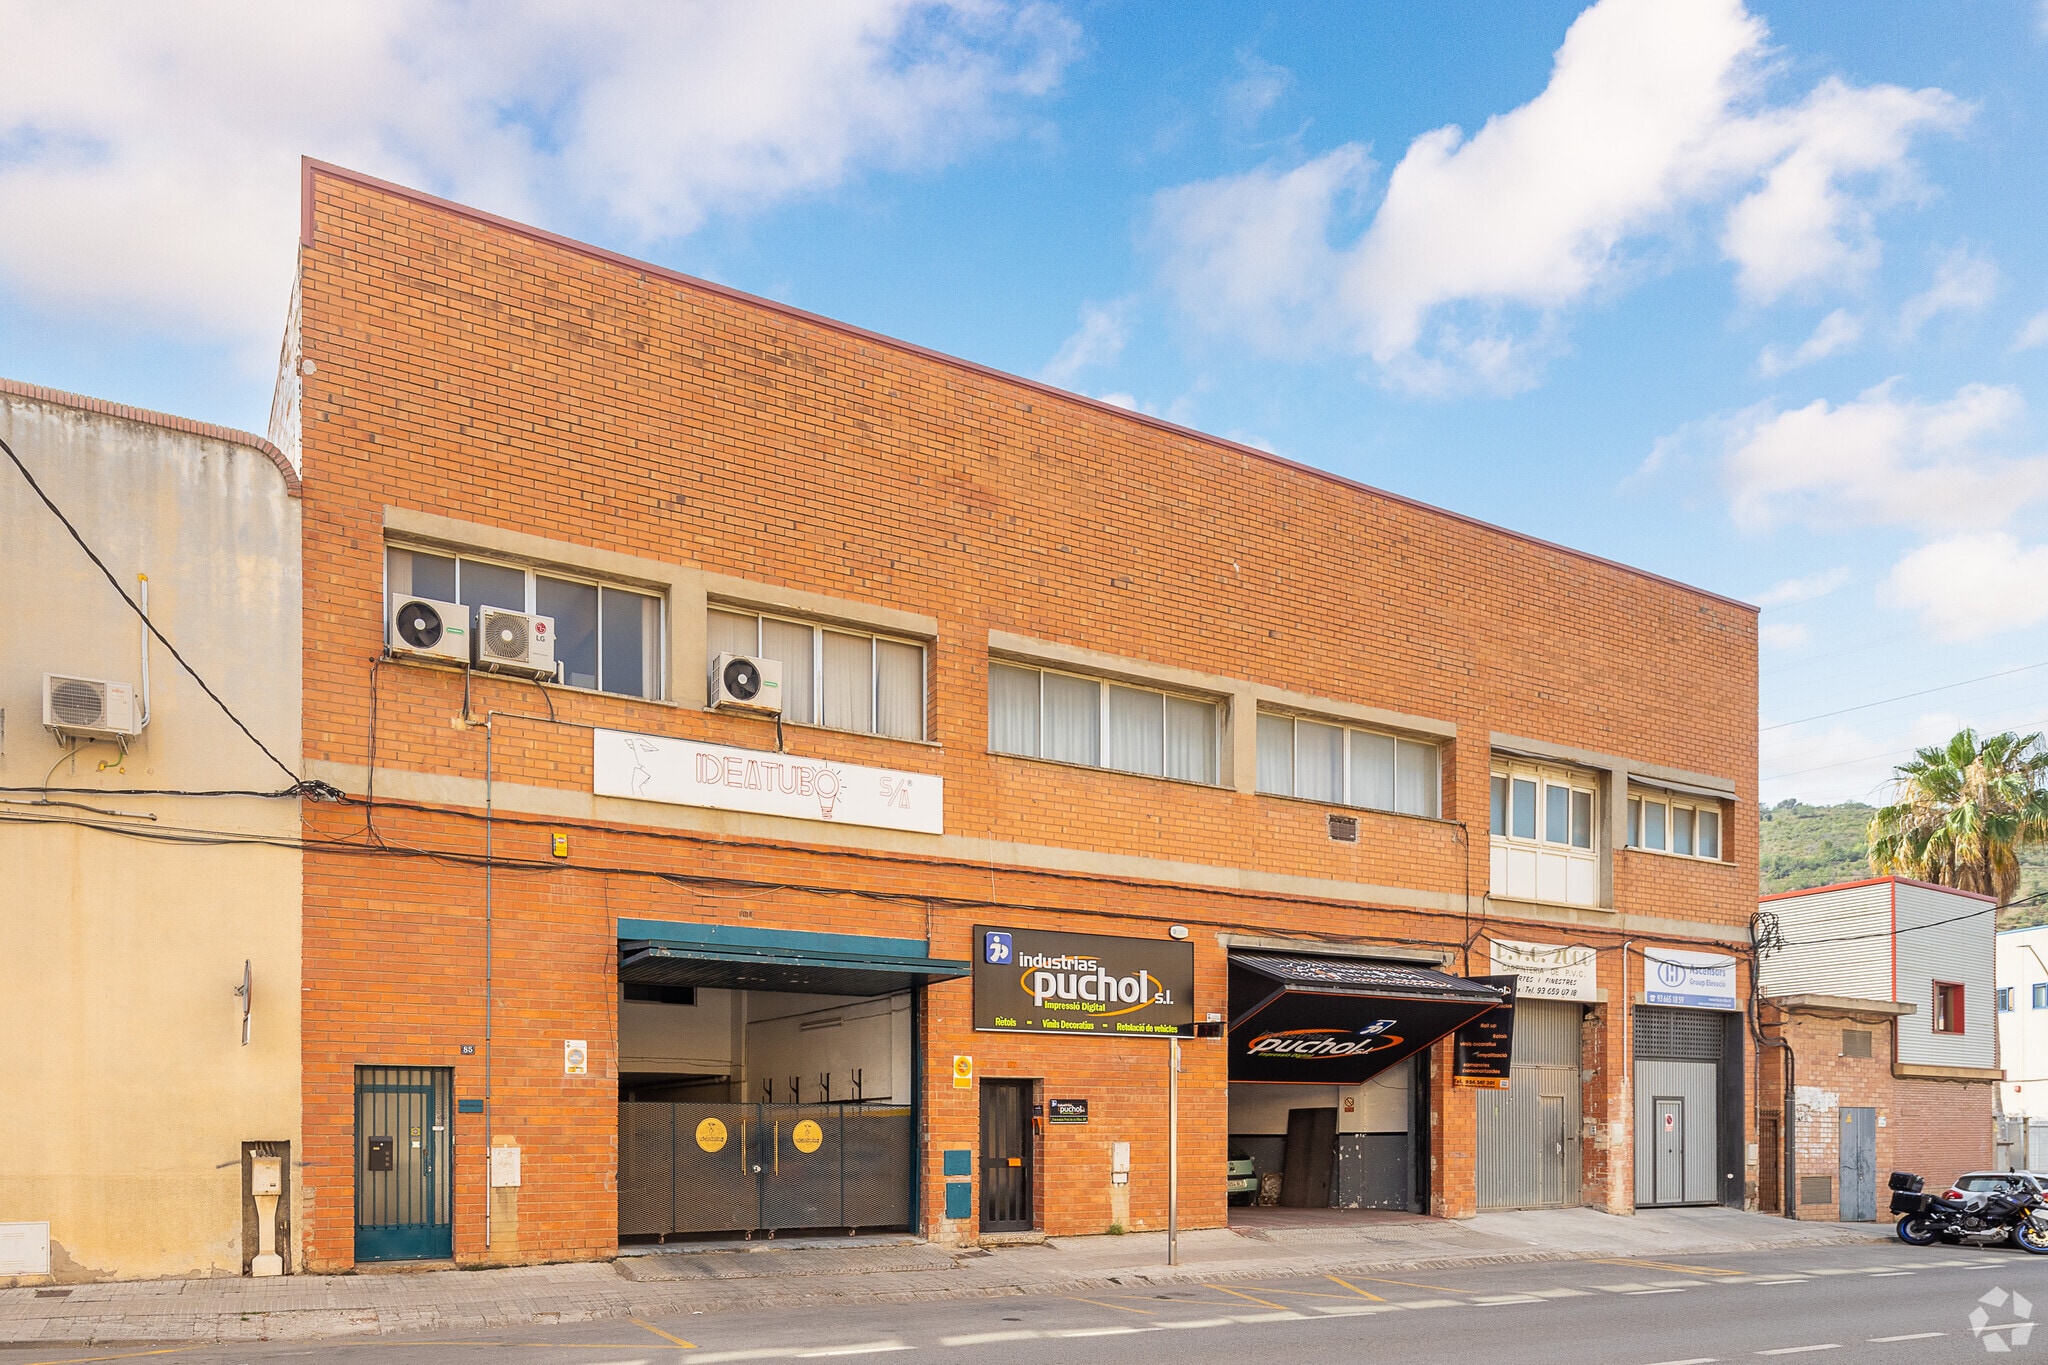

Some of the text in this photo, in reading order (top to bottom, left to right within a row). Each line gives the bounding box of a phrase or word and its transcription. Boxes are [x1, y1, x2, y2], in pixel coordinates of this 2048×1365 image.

[535, 634, 546, 642] LG
[696, 753, 839, 819] IDEATUBO
[1019, 952, 1097, 971] industrias
[1550, 968, 1560, 976] DE
[1034, 967, 1174, 1007] puchol s.l.
[1545, 977, 1577, 986] FINESTRES
[1044, 1000, 1106, 1012] Impressió Digital
[995, 1016, 1017, 1027] Rètols
[1145, 1024, 1154, 1032] de
[1247, 1037, 1373, 1055] puchol
